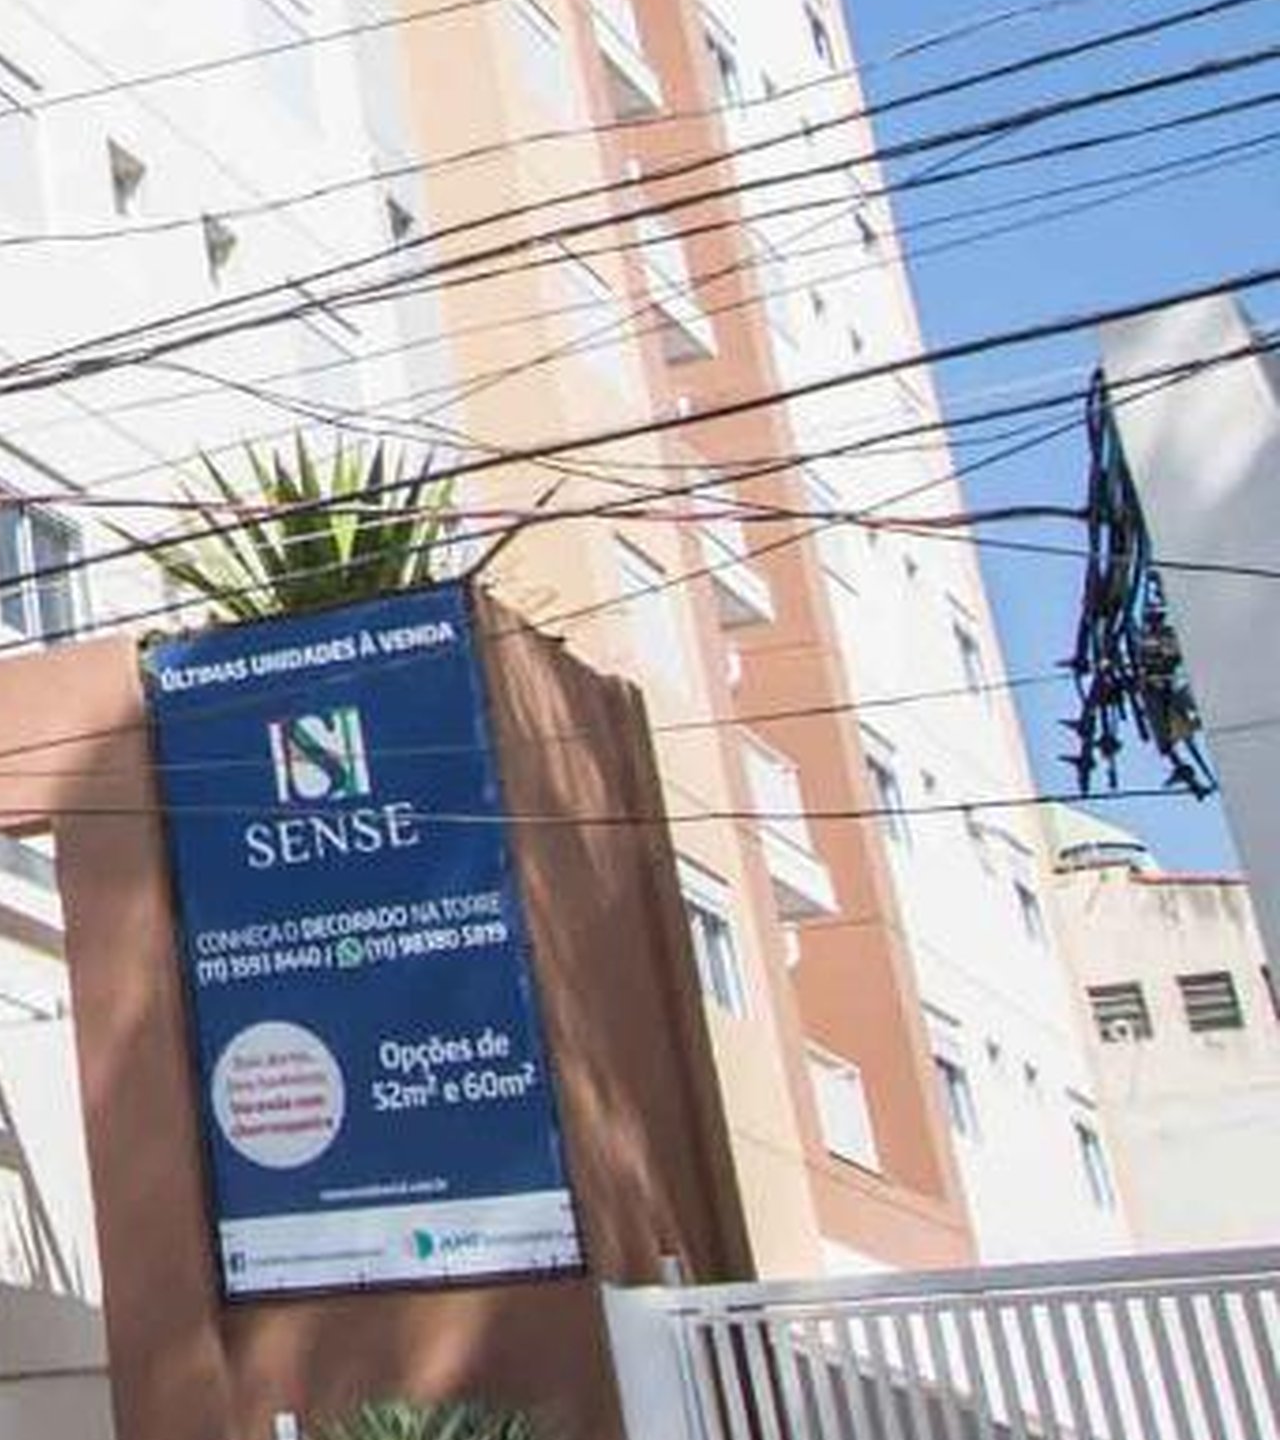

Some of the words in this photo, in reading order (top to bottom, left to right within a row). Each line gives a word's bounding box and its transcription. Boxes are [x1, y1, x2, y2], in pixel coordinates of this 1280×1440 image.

[160, 660, 248, 692] ÚLTIMAS
[251, 637, 356, 676] UNIDADES
[359, 628, 378, 658] À
[377, 621, 457, 652] VENDA
[245, 801, 420, 870] SENSE
[300, 904, 409, 940] DECORADO
[379, 1036, 472, 1074] Opções
[476, 1025, 510, 1059] de
[443, 1081, 461, 1103] e
[463, 1062, 536, 1102] 60m²
